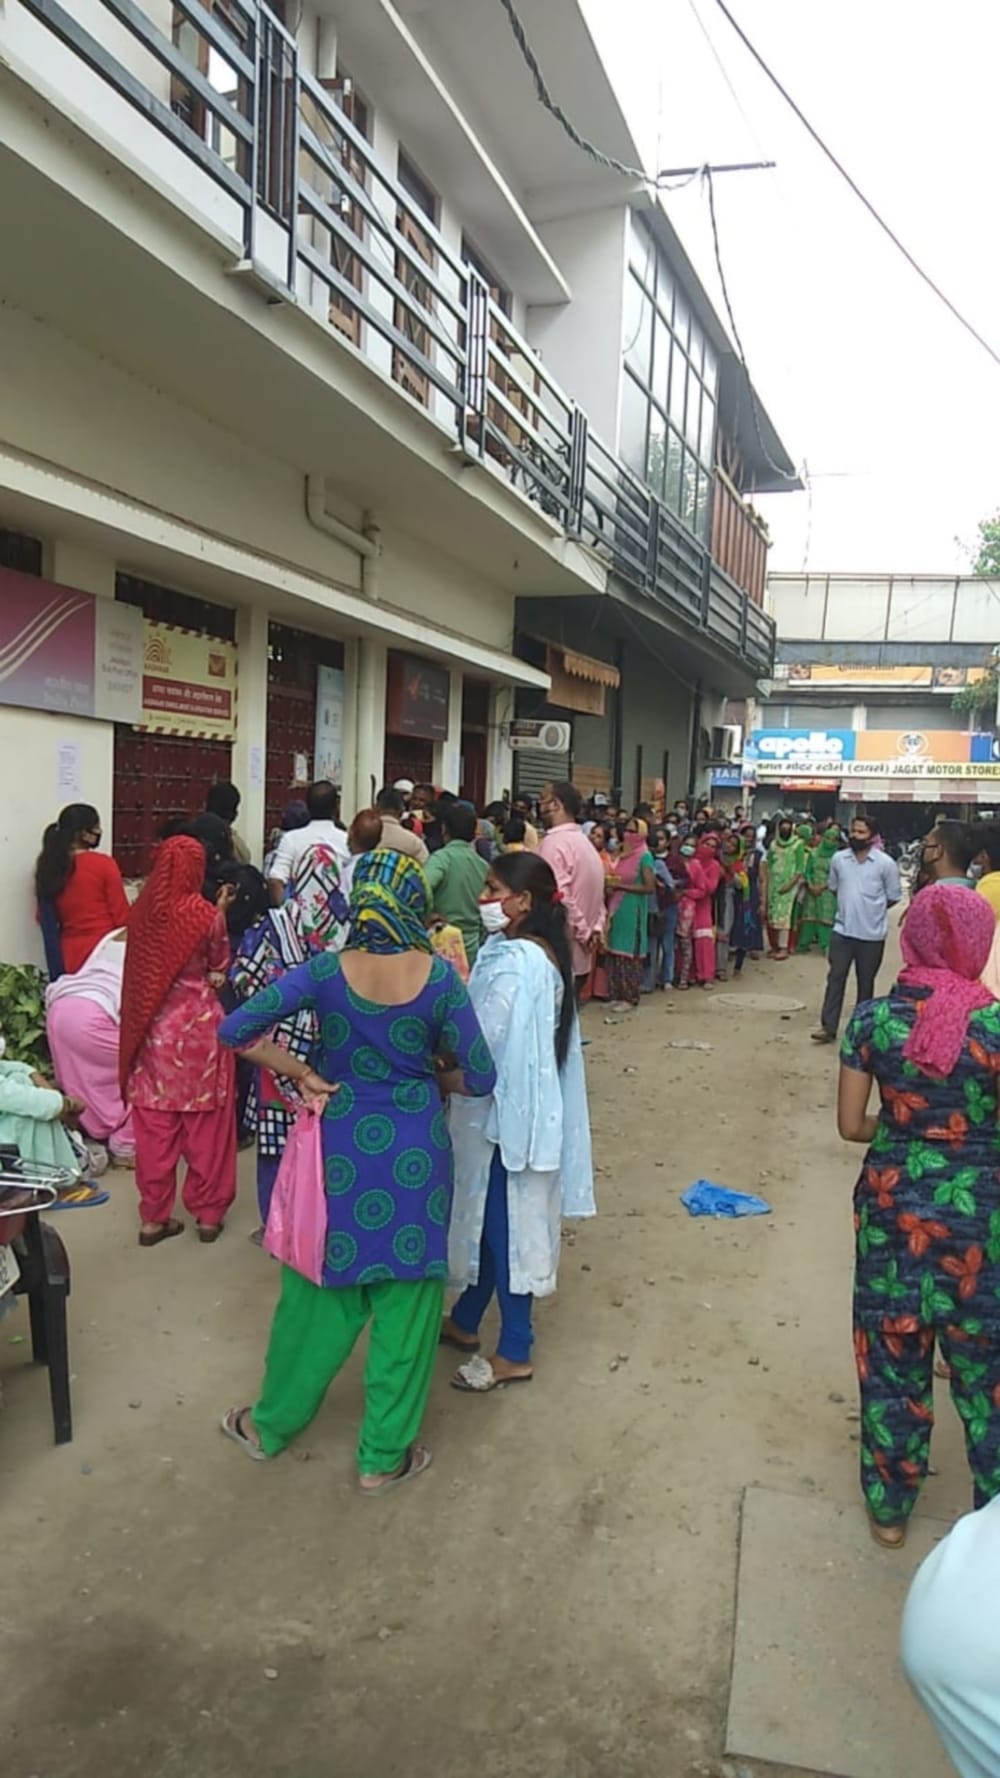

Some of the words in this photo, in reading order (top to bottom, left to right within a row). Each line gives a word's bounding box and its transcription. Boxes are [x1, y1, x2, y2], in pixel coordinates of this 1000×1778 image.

[758, 732, 843, 758] apollo
[892, 764, 924, 775] JAGAT
[927, 765, 961, 776] MOTOR
